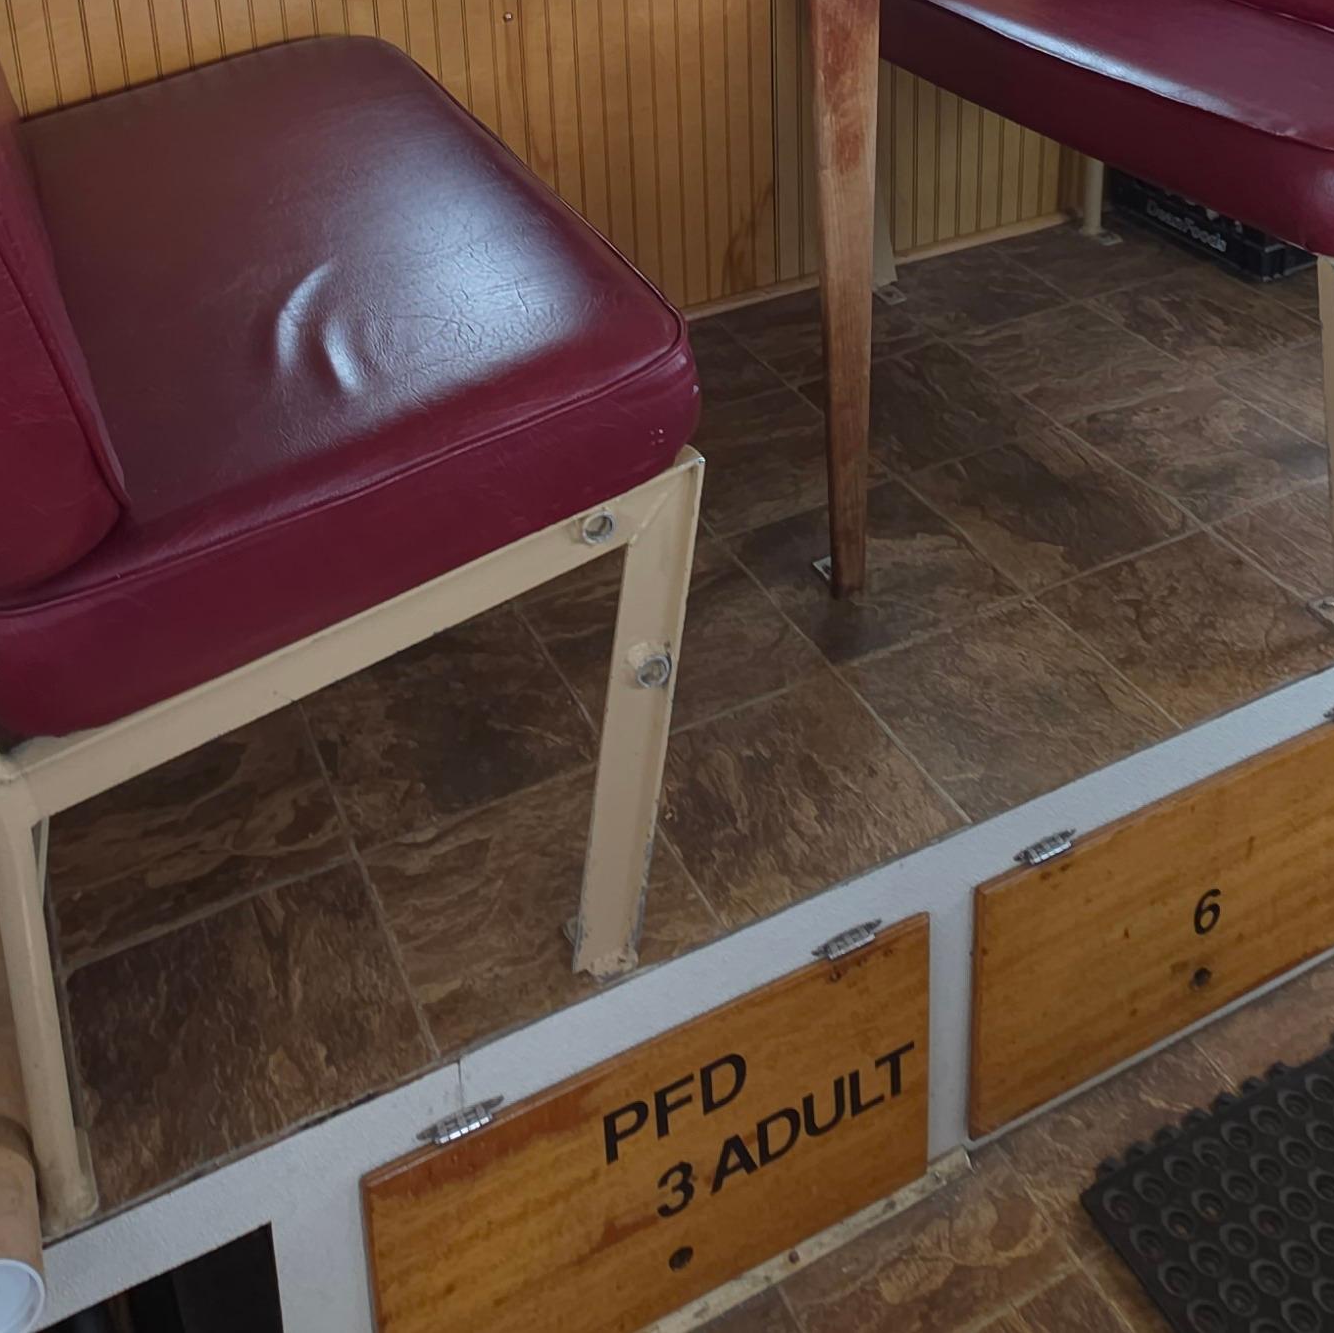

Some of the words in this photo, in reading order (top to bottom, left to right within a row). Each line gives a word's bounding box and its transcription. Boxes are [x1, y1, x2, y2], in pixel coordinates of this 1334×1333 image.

[1194, 888, 1221, 935] 6
[603, 1053, 747, 1165] PFD
[657, 1161, 694, 1218] 3
[710, 1041, 915, 1196] ADULT
